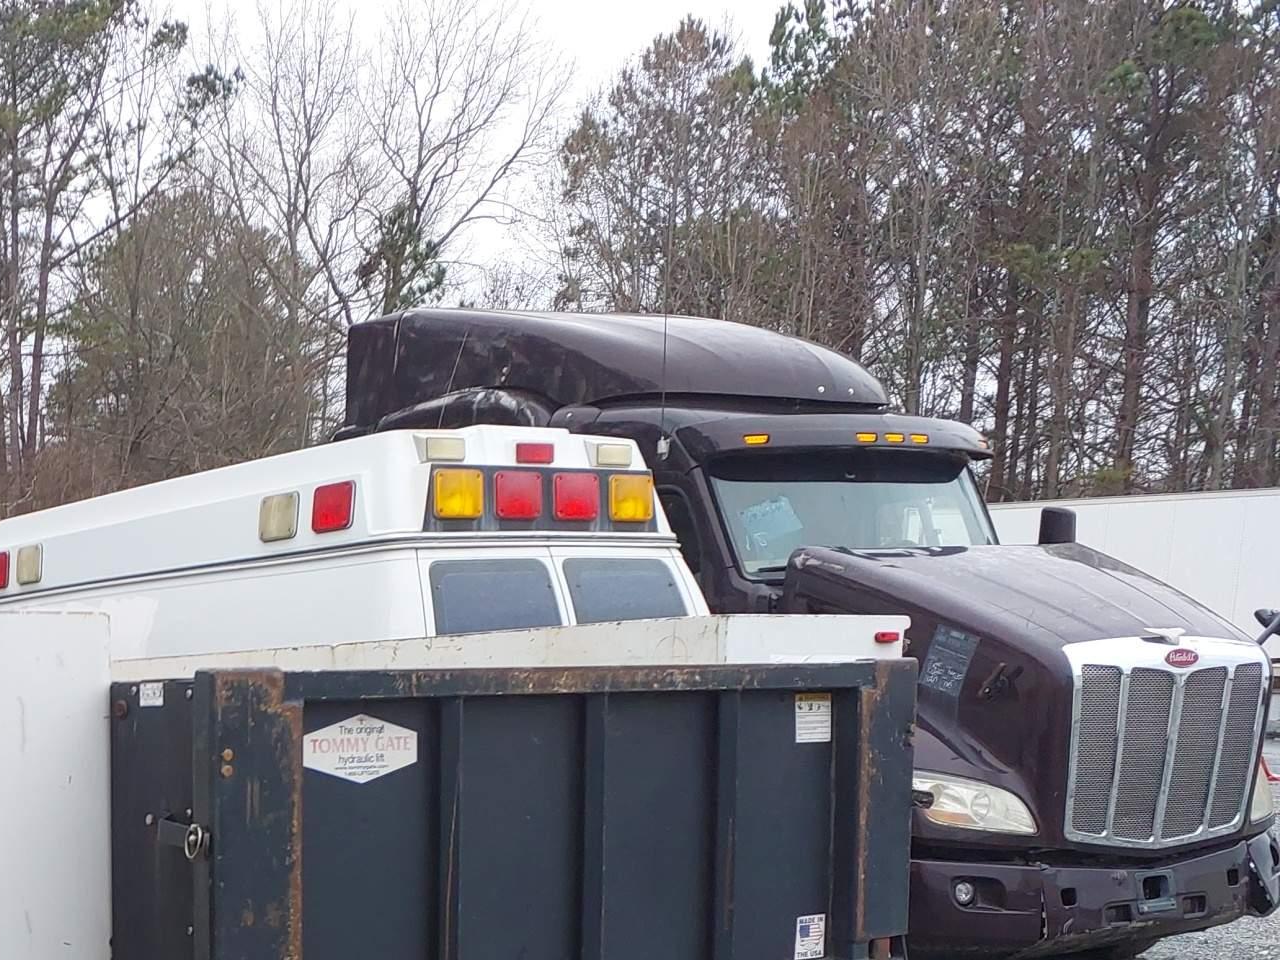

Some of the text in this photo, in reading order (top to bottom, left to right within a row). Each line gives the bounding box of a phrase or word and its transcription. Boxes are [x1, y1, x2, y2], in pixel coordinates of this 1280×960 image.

[339, 724, 384, 736] The original
[310, 736, 412, 753] TOMMY GATE
[338, 754, 374, 766] hydraulic
[810, 949, 822, 957] USA
